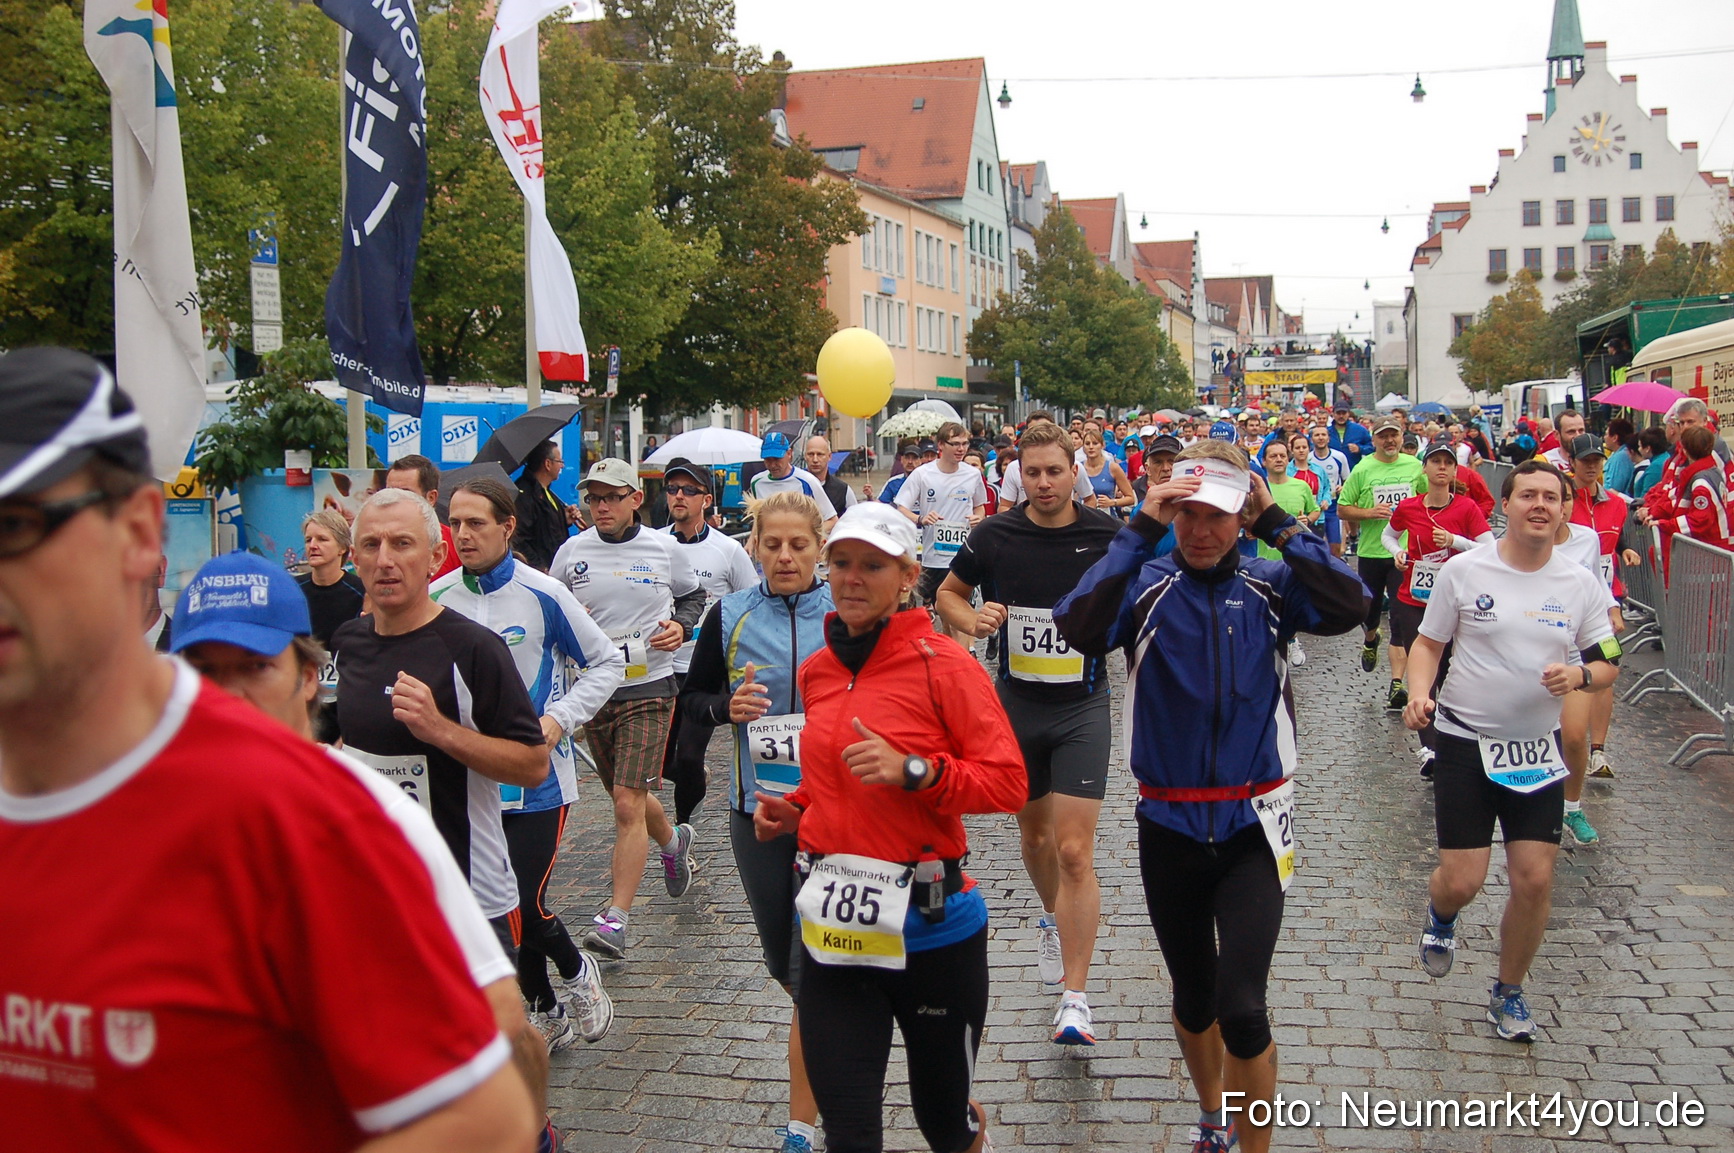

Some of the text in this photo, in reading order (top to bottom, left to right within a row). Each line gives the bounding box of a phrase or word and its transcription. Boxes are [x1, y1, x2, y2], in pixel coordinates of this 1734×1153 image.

[1274, 374, 1306, 382] START
[937, 529, 967, 543] 3046
[188, 573, 269, 597] GANSBRÄU
[1009, 613, 1033, 622] PARTL
[611, 633, 631, 641] markt
[1022, 626, 1071, 655] 545
[750, 724, 782, 733] PARTL
[1489, 738, 1553, 768] 2082
[373, 766, 407, 776] markt
[1506, 773, 1547, 784] Thomas
[840, 866, 891, 884] Neumarkt
[821, 880, 883, 926] 185
[823, 931, 862, 951] Karin
[0, 993, 92, 1058] RKT
